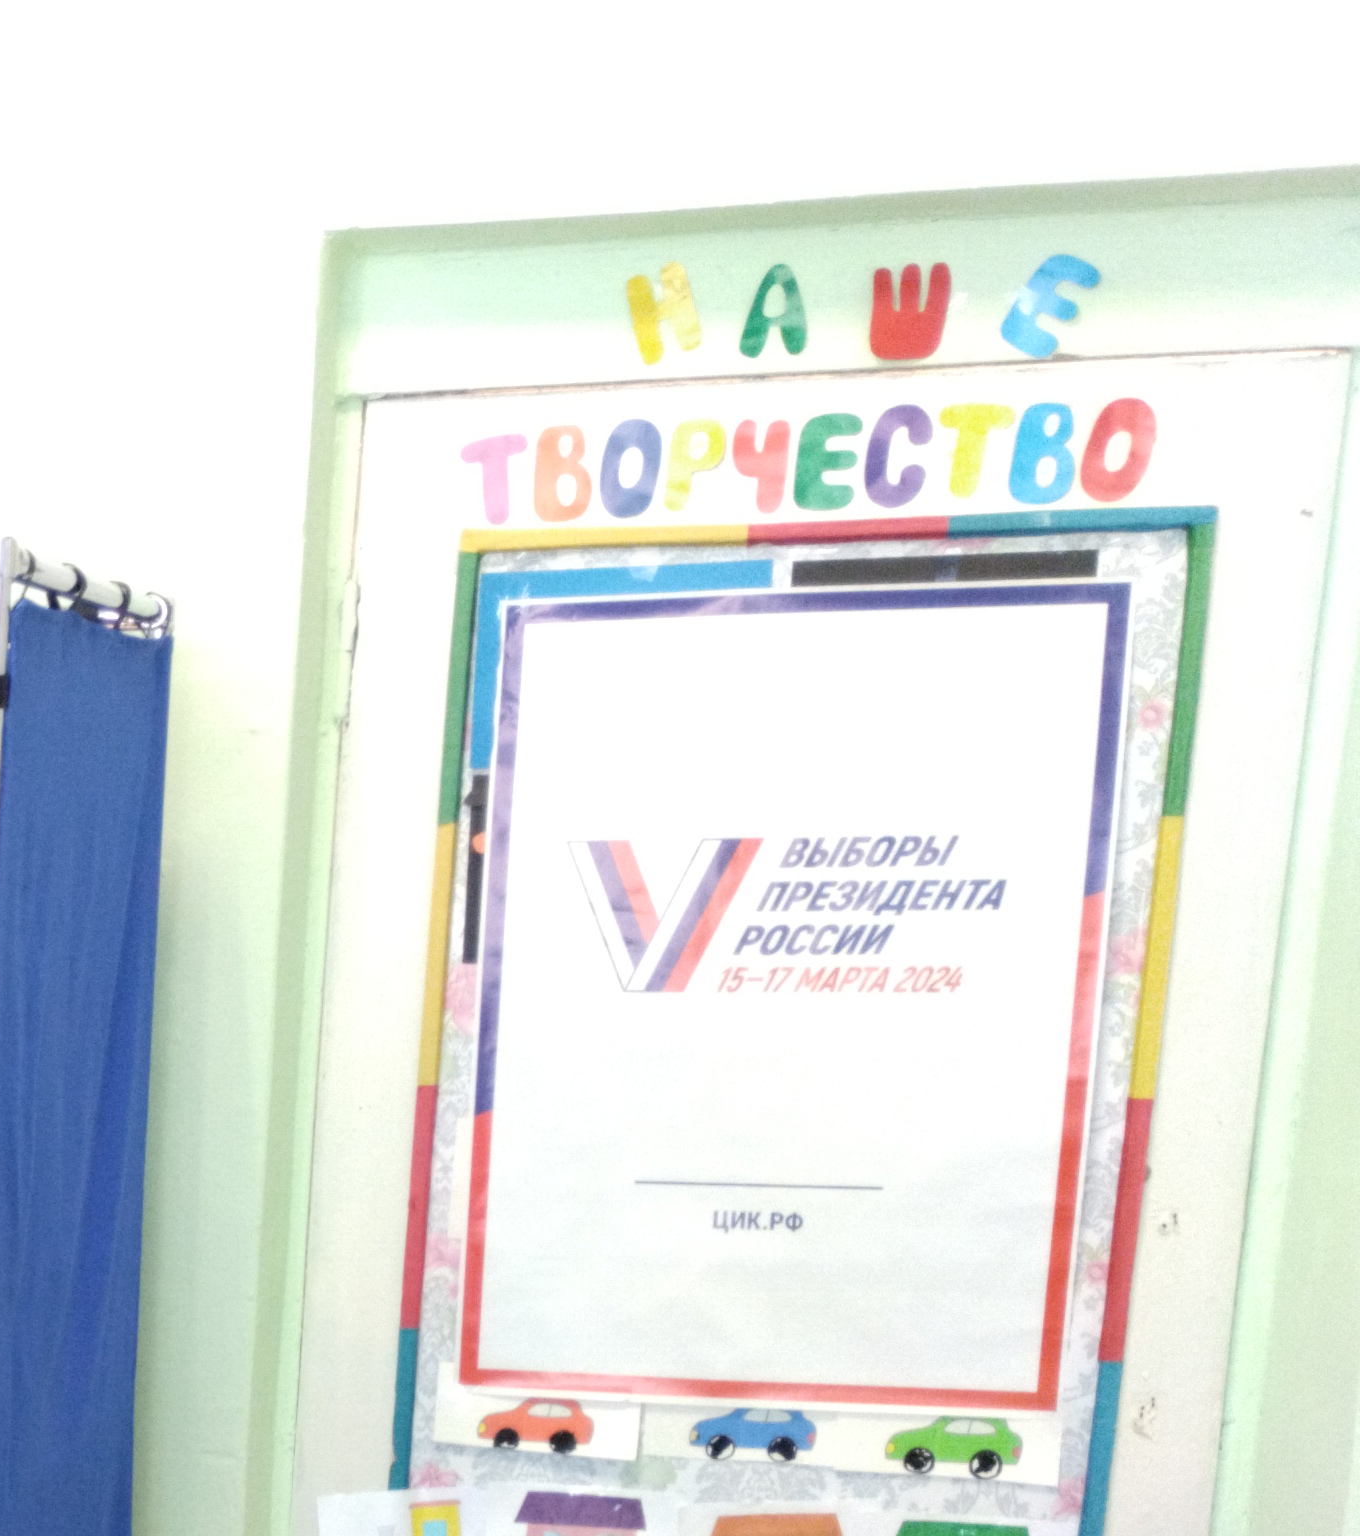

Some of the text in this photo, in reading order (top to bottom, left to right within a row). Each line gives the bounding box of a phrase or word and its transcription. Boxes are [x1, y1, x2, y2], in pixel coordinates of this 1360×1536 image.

[626, 253, 1102, 365] НАШЕ
[460, 396, 1157, 525] ТВОРЧЕСТВО
[779, 834, 959, 869] ВЫБОРЫ
[756, 878, 1007, 915] ПРЕЗИДЕНТА
[733, 923, 895, 956] РОССИИ
[794, 967, 888, 993] МАРТА
[893, 966, 963, 993] 2024
[711, 1209, 804, 1233] ЦИК.РФ
